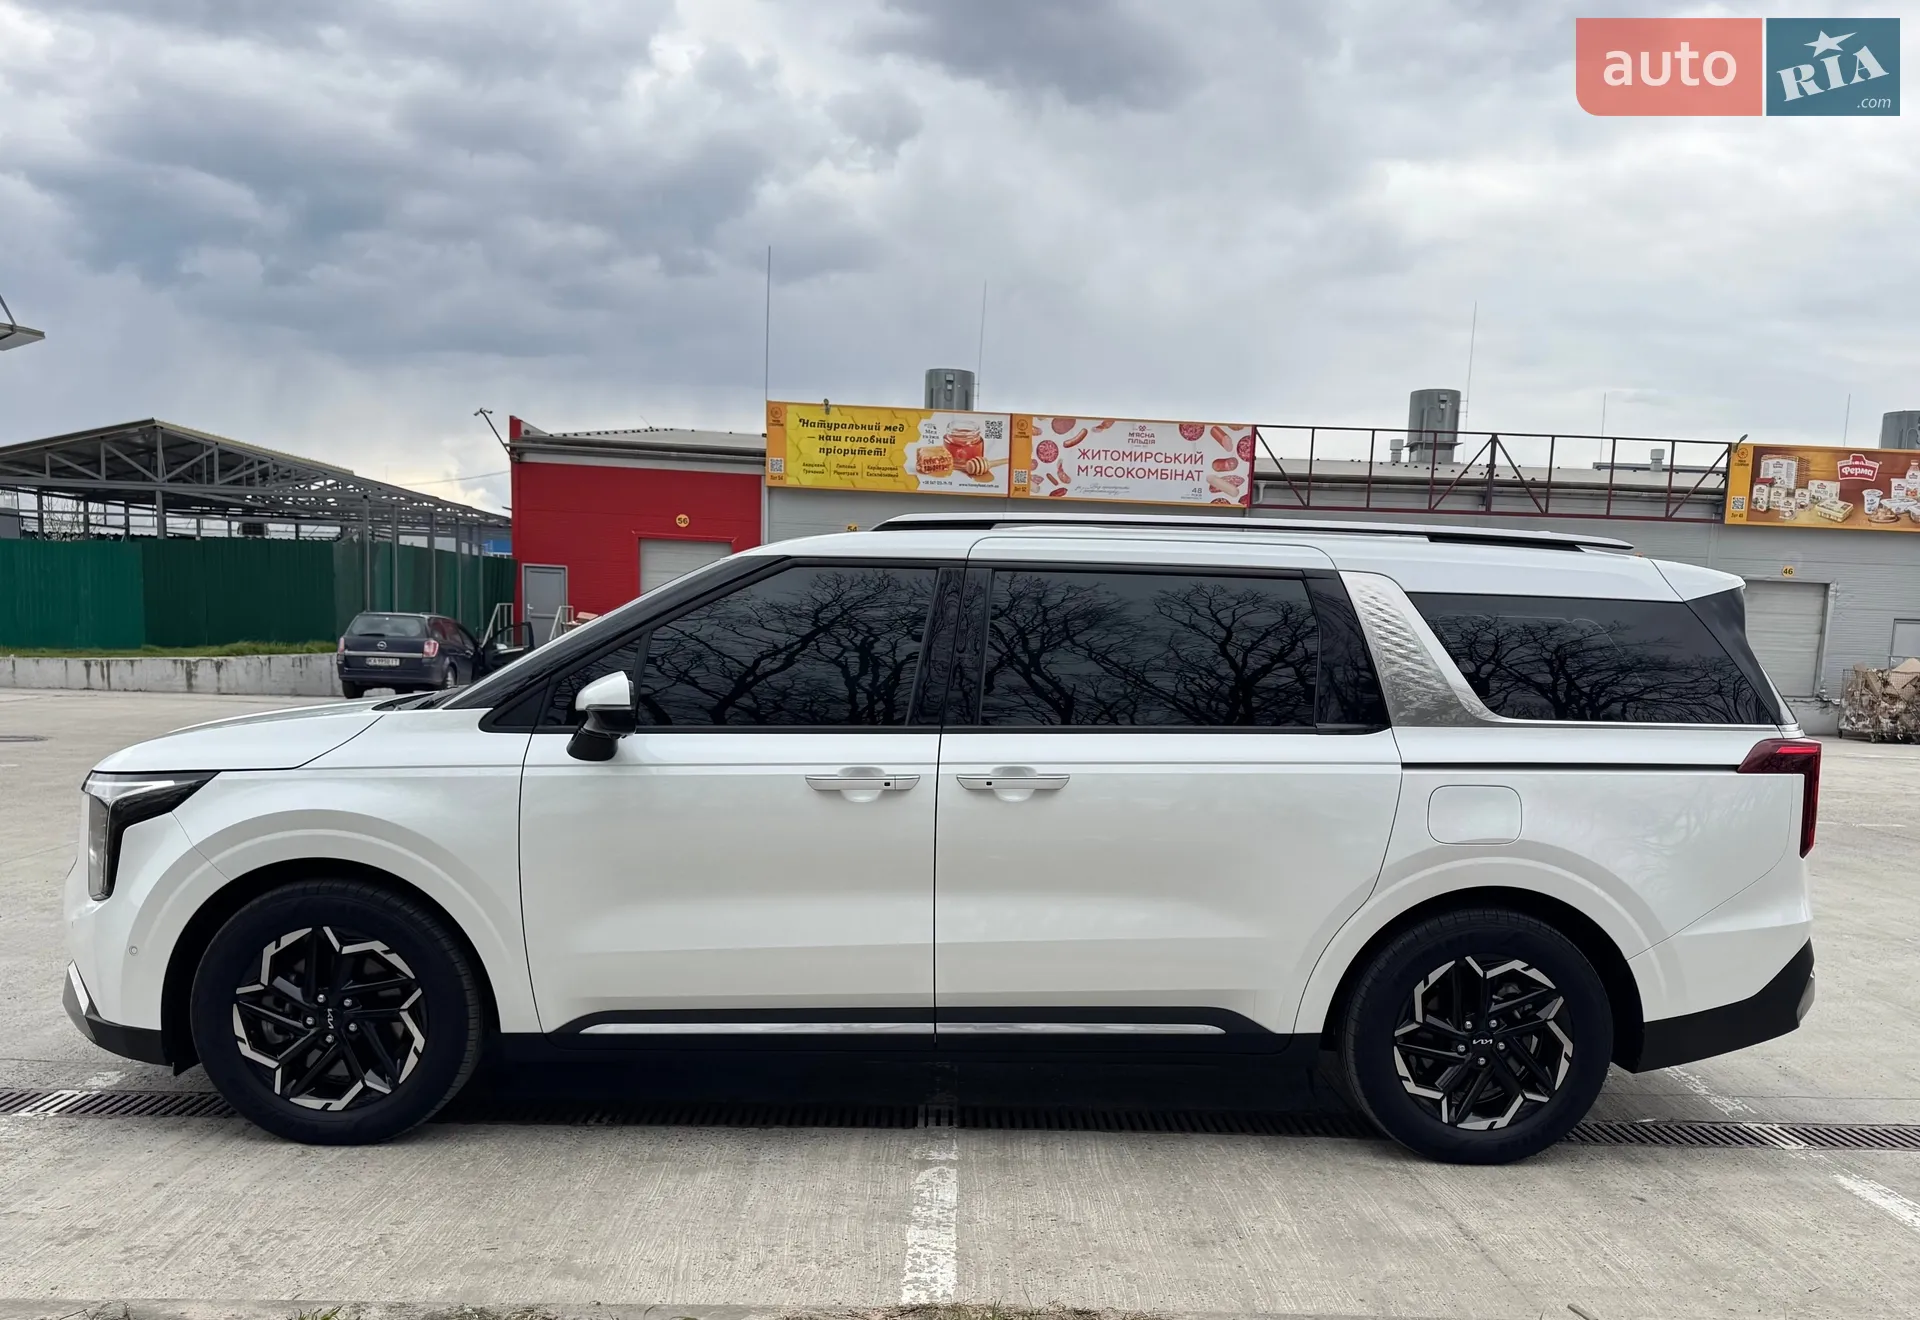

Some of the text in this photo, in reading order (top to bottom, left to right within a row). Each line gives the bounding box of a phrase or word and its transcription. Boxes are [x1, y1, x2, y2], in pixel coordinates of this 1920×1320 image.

[884, 423, 905, 433] мед
[818, 434, 842, 442] наш
[844, 435, 896, 445] головний
[818, 446, 887, 457] пріоритет!
[1077, 448, 1204, 465] ЖИТОМИРСЬКИЙ
[1077, 465, 1204, 482] М'ЯСОКОМБІНАТ
[1841, 466, 1874, 477] Ферма
[677, 517, 688, 525] 56
